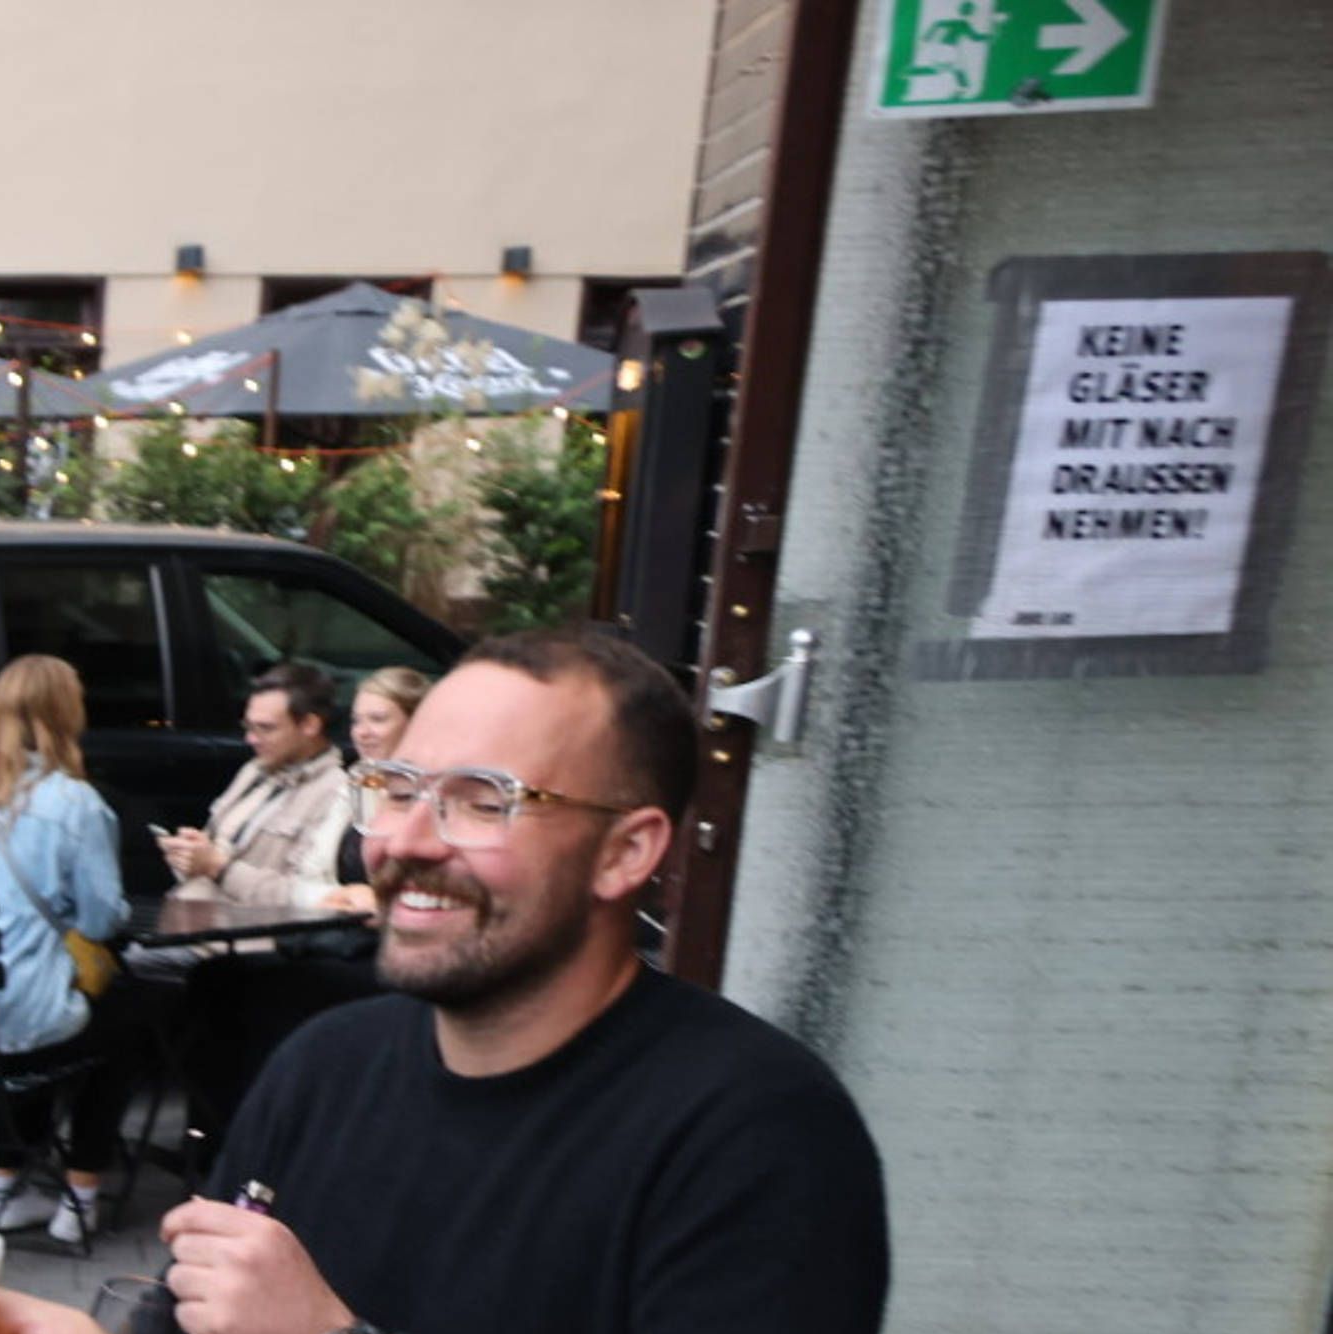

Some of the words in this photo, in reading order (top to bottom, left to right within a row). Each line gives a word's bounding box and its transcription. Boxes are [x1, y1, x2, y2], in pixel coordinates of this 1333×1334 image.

[1077, 325, 1185, 357] KEINE
[1068, 362, 1210, 403] GLÄSER
[1059, 418, 1131, 448] MIT
[1136, 418, 1238, 448] NACH
[1051, 463, 1235, 494] DRAUSSEN
[1042, 509, 1210, 540] NEHMEN!
